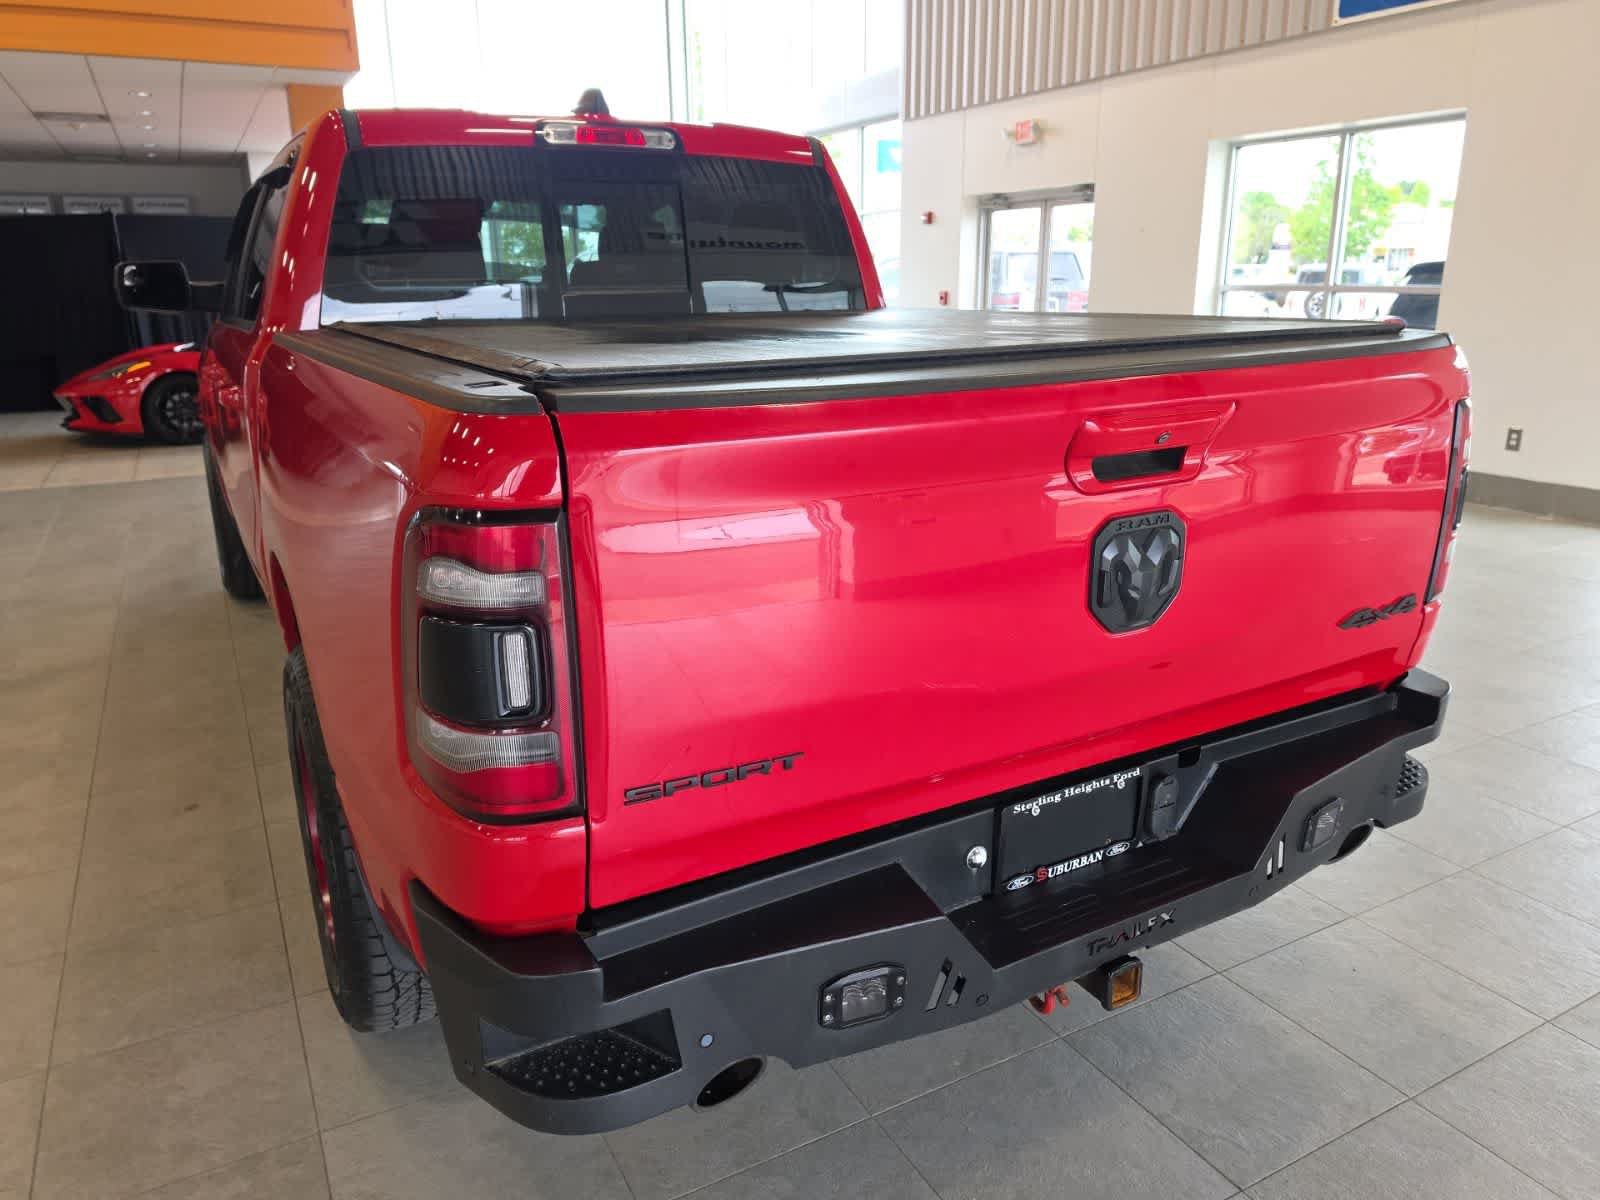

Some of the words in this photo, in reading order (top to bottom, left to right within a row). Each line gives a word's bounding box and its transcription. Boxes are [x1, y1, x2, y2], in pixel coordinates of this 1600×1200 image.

[1115, 513, 1170, 532] RAM
[624, 751, 805, 807] SPORT
[1013, 794, 1062, 815] Sterling
[1064, 778, 1111, 797] Heights
[1112, 767, 1140, 784] Ford
[1036, 850, 1104, 882] SUBURBAN
